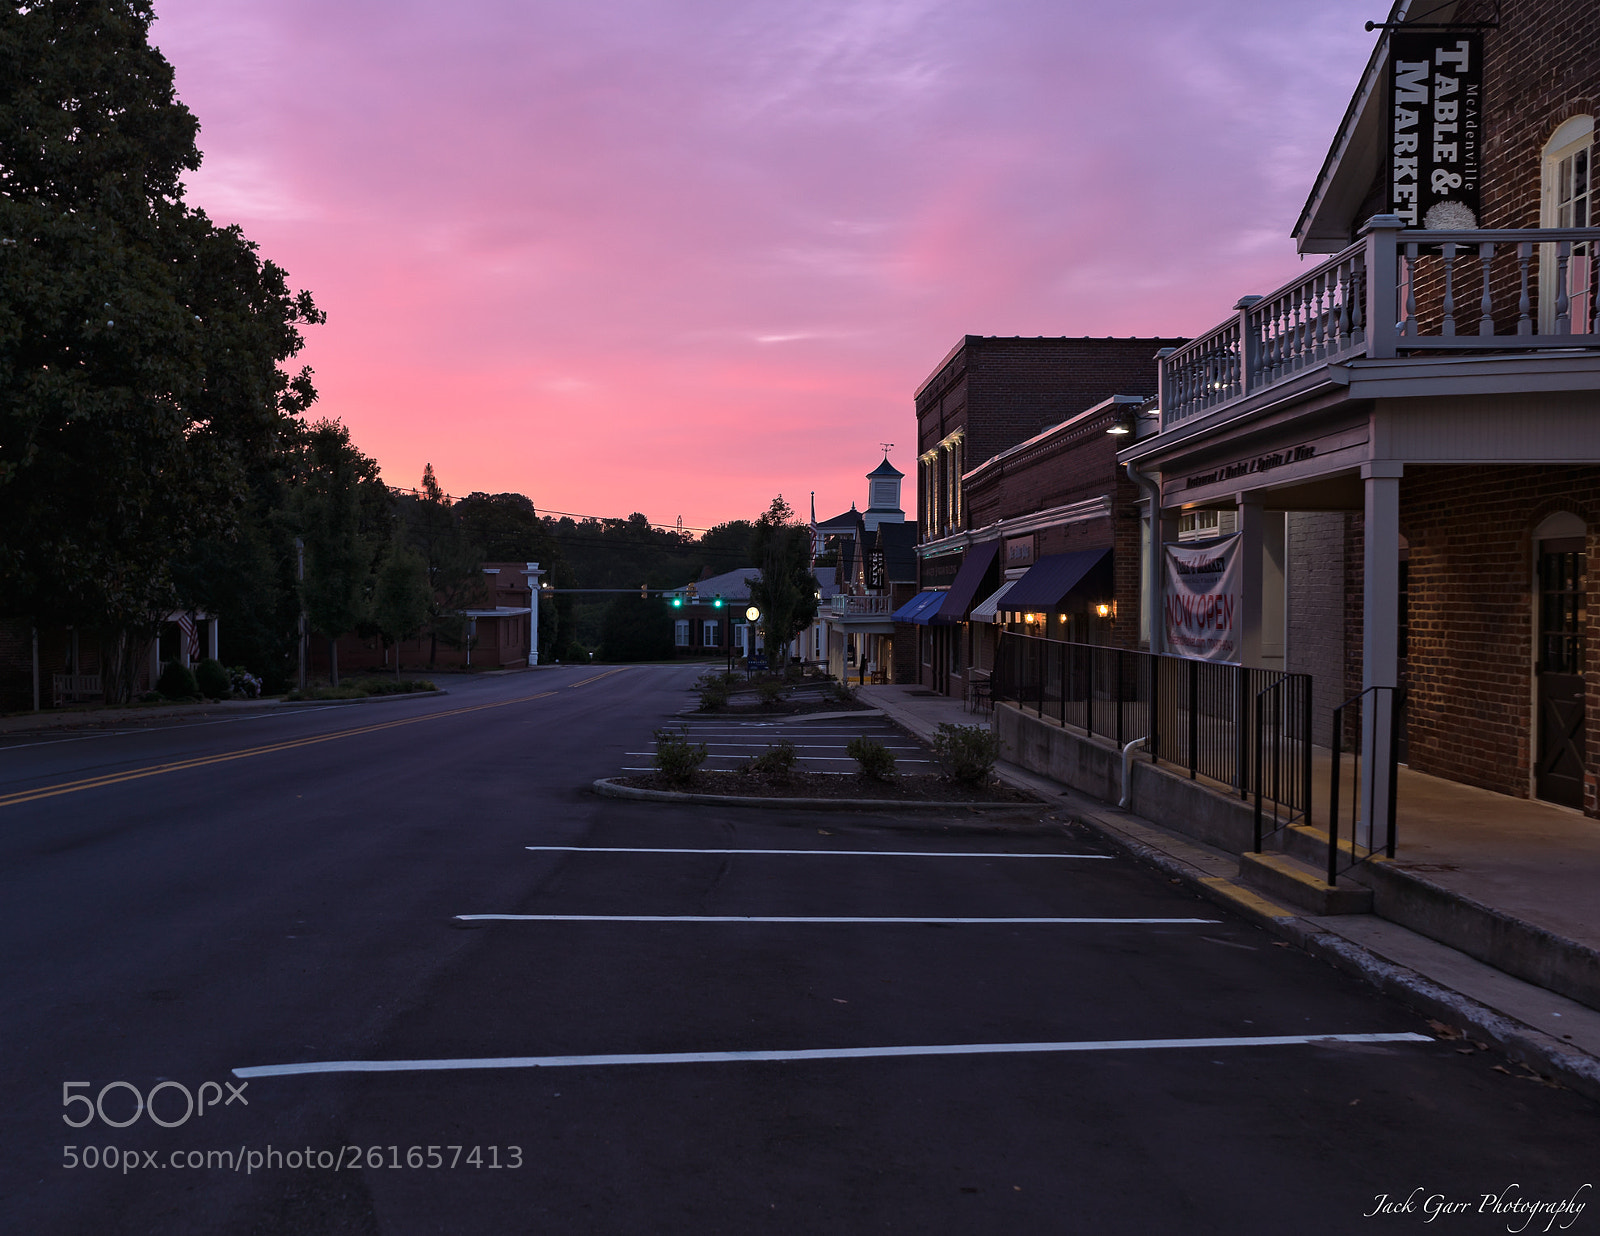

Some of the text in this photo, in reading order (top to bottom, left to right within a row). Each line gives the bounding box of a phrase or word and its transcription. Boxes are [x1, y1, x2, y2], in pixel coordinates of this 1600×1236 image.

[1393, 59, 1430, 226] MARKET
[1430, 40, 1470, 195] TABLE &
[1464, 84, 1479, 192] McAdenville
[1225, 462, 1249, 479] Market
[1257, 453, 1283, 473] Spirits
[1294, 445, 1315, 461] Wine
[1166, 594, 1234, 630] NOW OPEN
